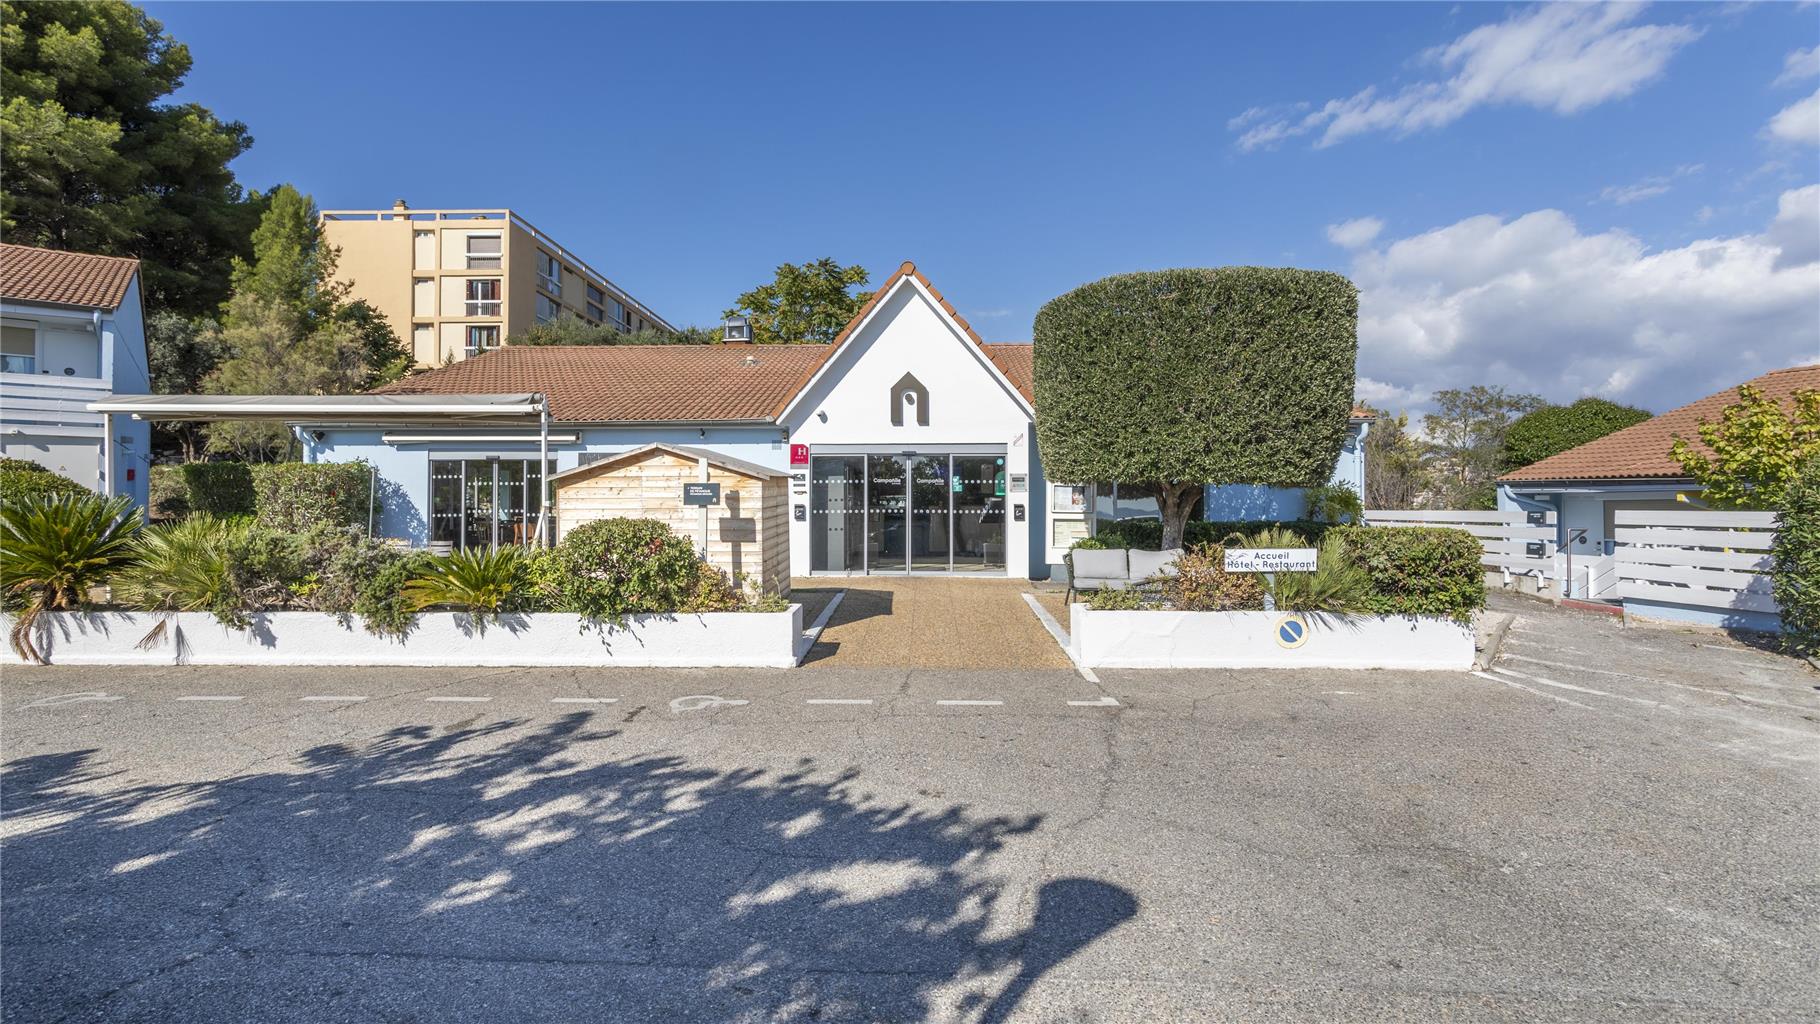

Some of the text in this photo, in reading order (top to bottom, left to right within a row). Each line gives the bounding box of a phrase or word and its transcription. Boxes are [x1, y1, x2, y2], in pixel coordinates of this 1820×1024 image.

[798, 447, 806, 455] H
[1254, 552, 1289, 560] Accueil
[1227, 560, 1253, 569] Hôtel
[1262, 561, 1315, 569] Restaurant
